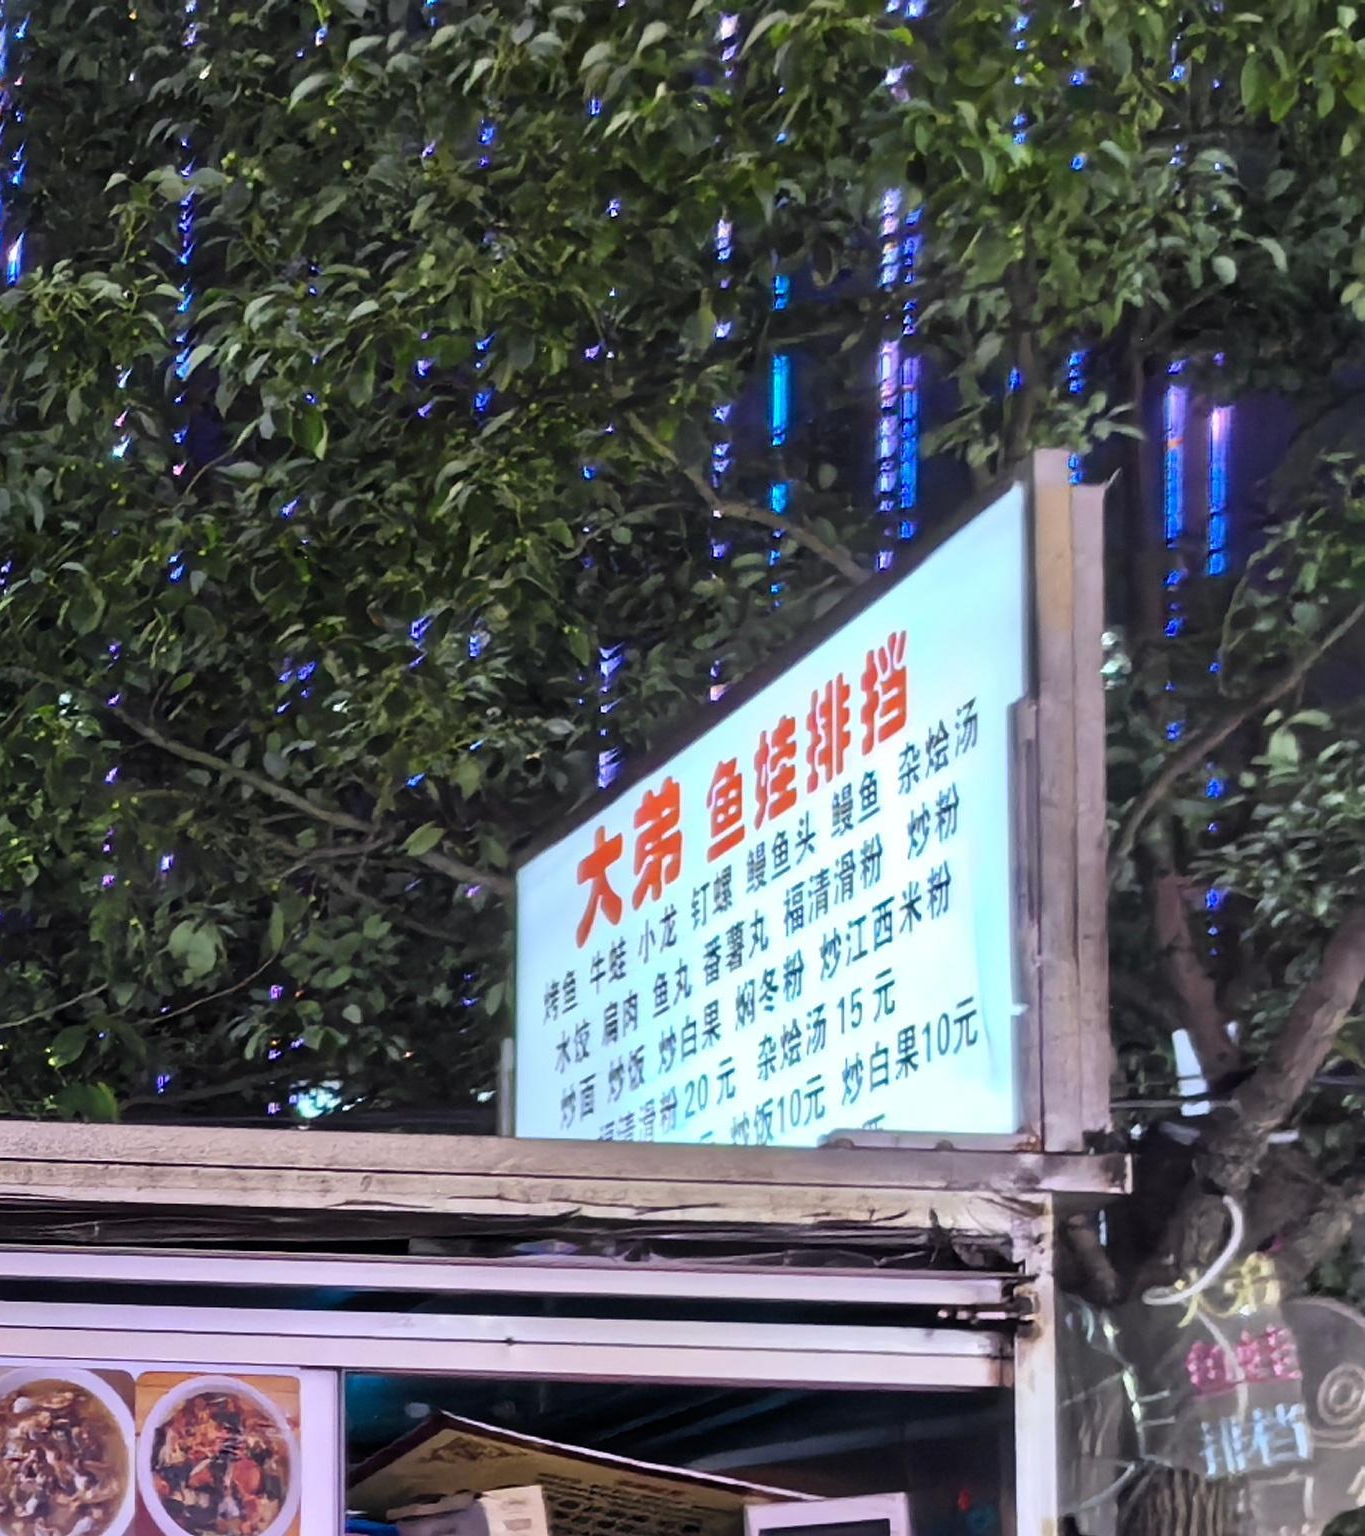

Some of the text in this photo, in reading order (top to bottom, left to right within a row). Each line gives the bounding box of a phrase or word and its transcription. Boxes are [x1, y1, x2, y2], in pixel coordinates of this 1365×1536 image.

[555, 1018, 591, 1075] 水饺
[652, 957, 692, 1018] 鱼丸
[703, 908, 769, 987] 番薯丸
[784, 833, 882, 937] 福清滑粉
[907, 782, 959, 860] 炒粉
[590, 936, 626, 994] 牛蛙
[639, 903, 677, 964] 小龙
[691, 864, 732, 930] 钉螺
[746, 810, 816, 893] 鳗鱼头
[831, 770, 880, 837] 鳗鱼
[898, 697, 978, 795] 杂烩汤
[608, 1044, 645, 1103] 炒饭
[658, 998, 721, 1075] 炒白果
[735, 949, 804, 1031] 焖冬粉
[819, 860, 951, 981] 炒江西米粉
[841, 996, 978, 1106] 炒白果10元
